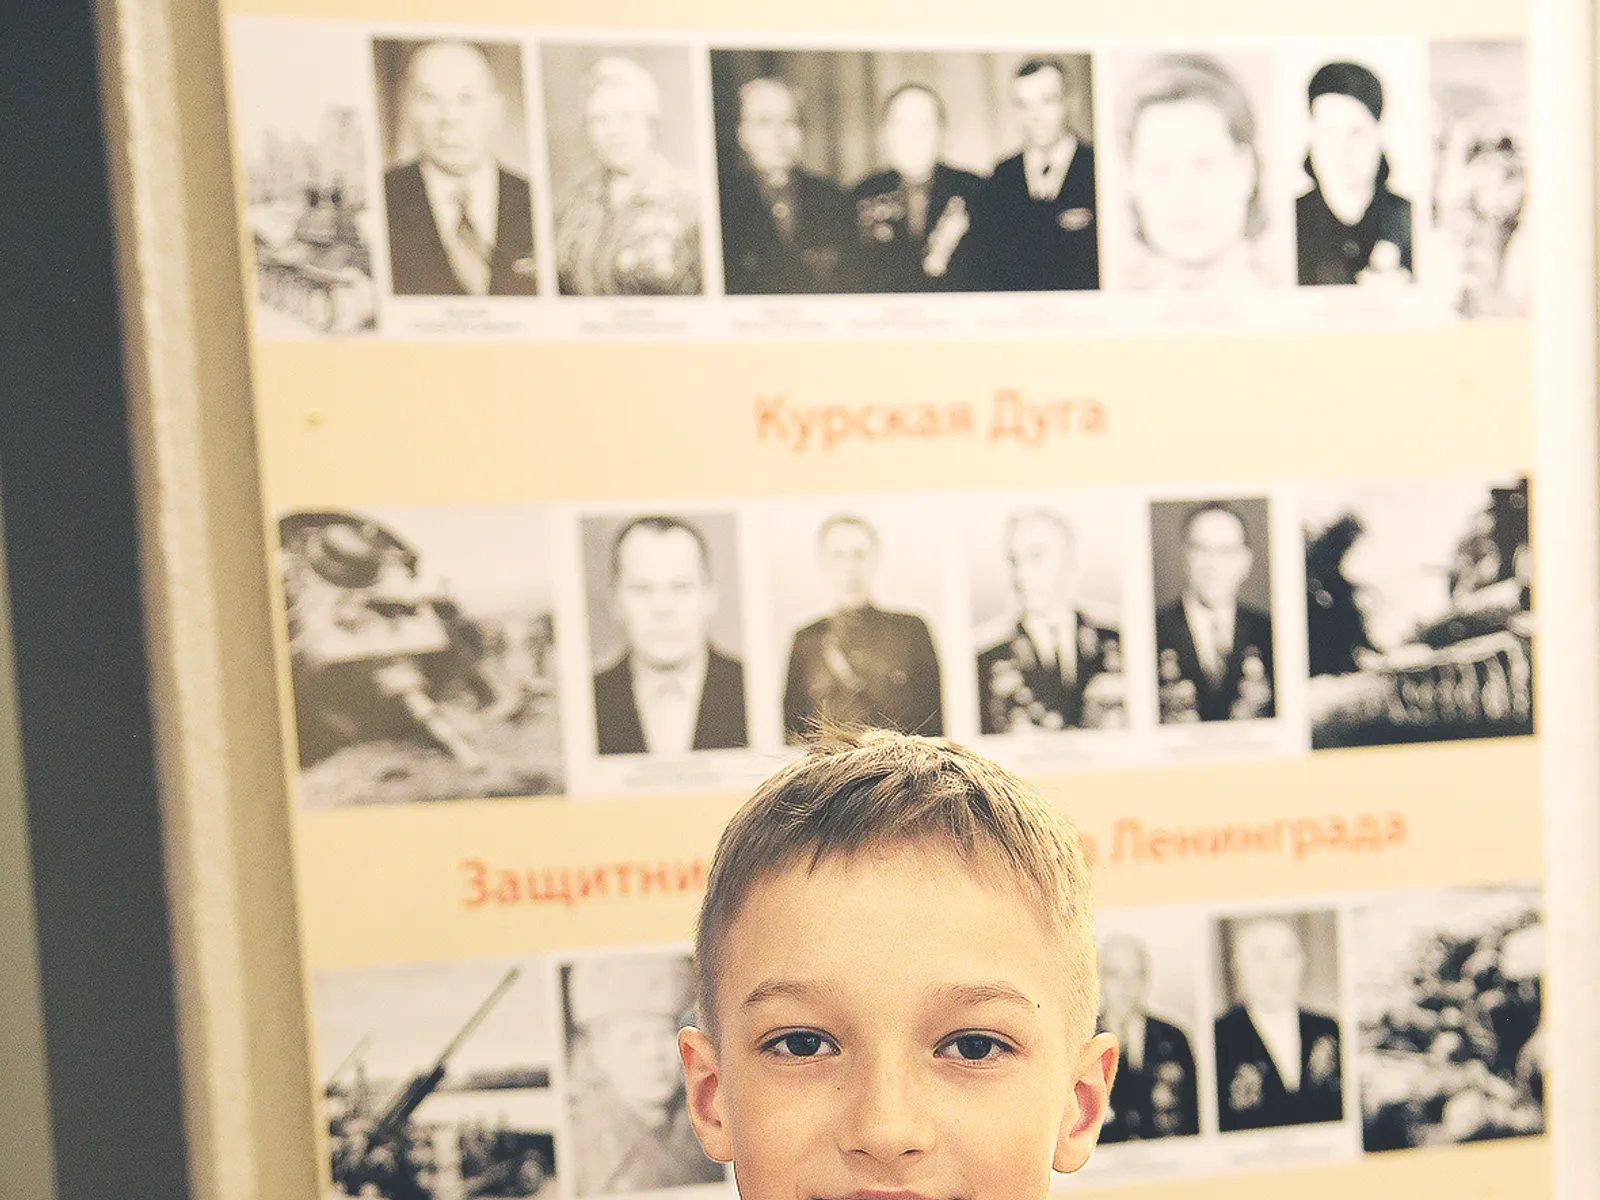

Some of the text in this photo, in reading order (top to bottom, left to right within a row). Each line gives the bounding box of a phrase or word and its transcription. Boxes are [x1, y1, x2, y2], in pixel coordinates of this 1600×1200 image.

[755, 388, 1107, 453] Курская Дуга
[458, 858, 706, 908] Защитни
[1110, 811, 1406, 863] Ленинграда
